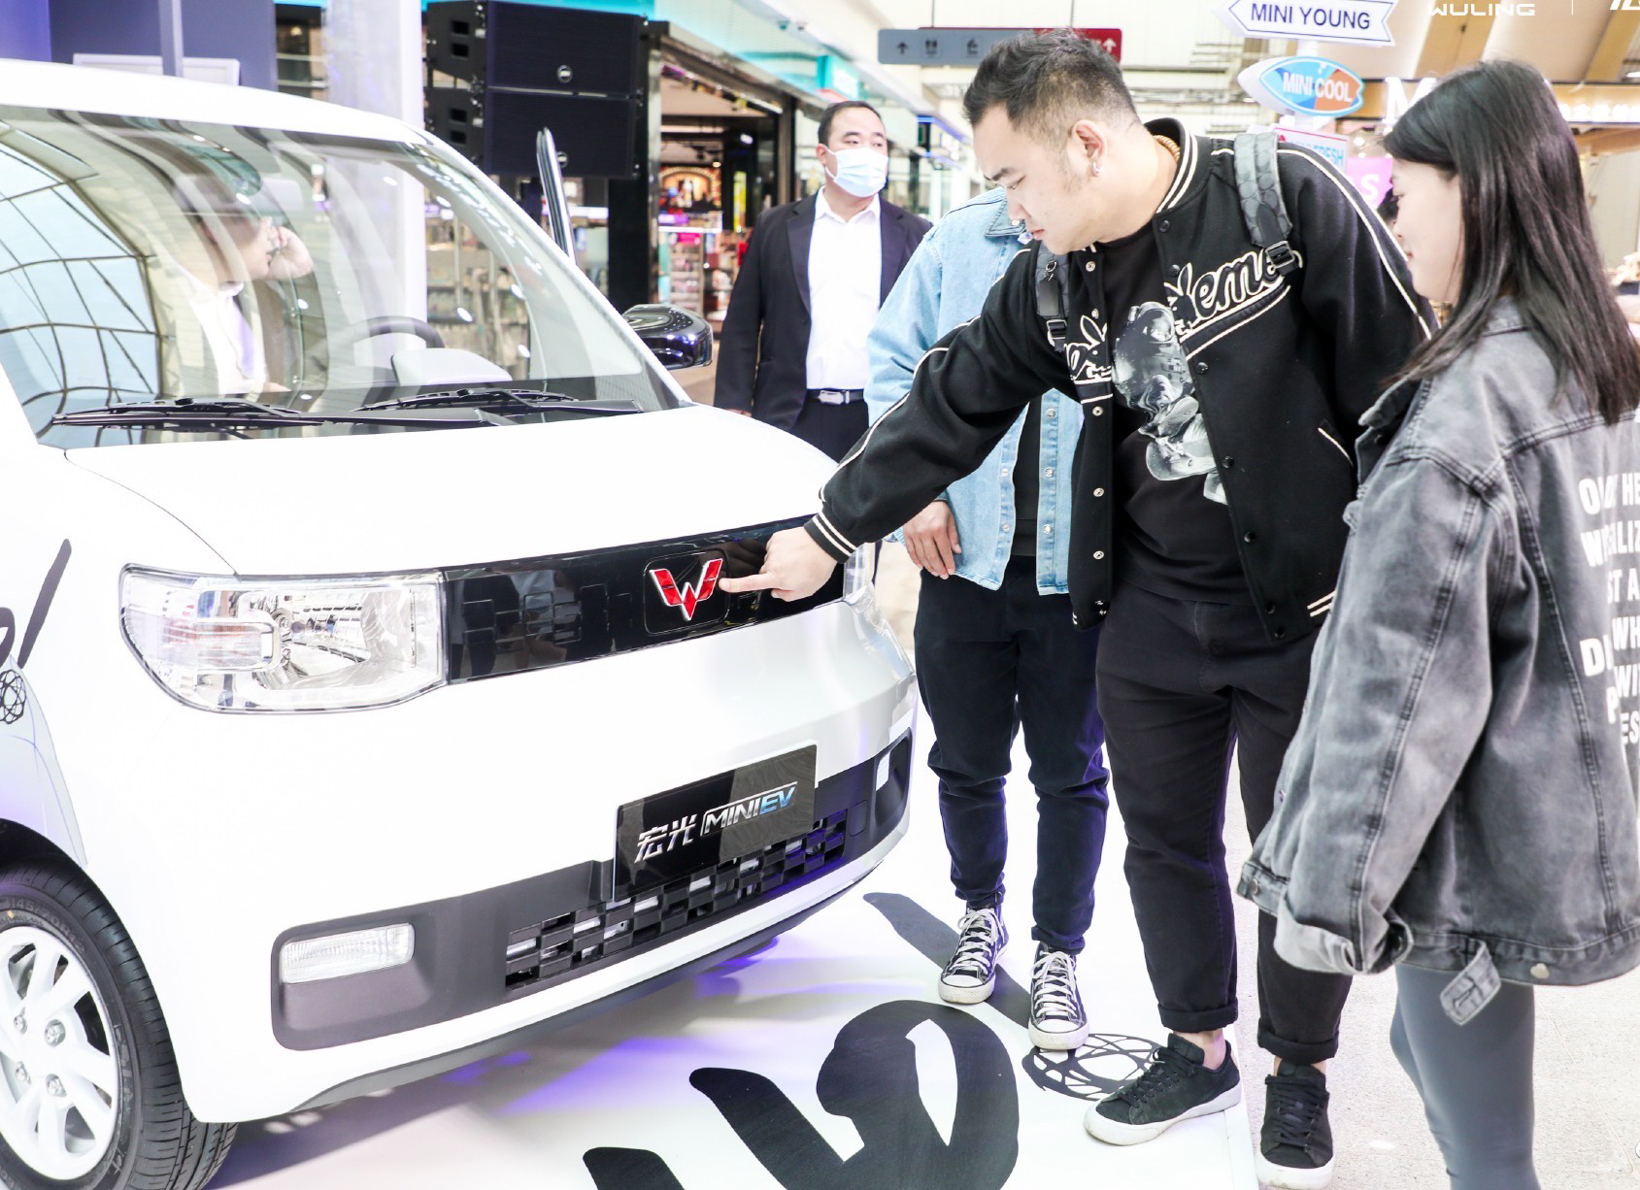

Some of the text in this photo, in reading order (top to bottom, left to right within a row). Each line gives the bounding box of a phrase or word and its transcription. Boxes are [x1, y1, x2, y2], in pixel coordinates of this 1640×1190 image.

[1250, 3, 1371, 30] MINI YOUNG
[1282, 72, 1353, 102] MINI COOL
[634, 813, 698, 864] 宏光
